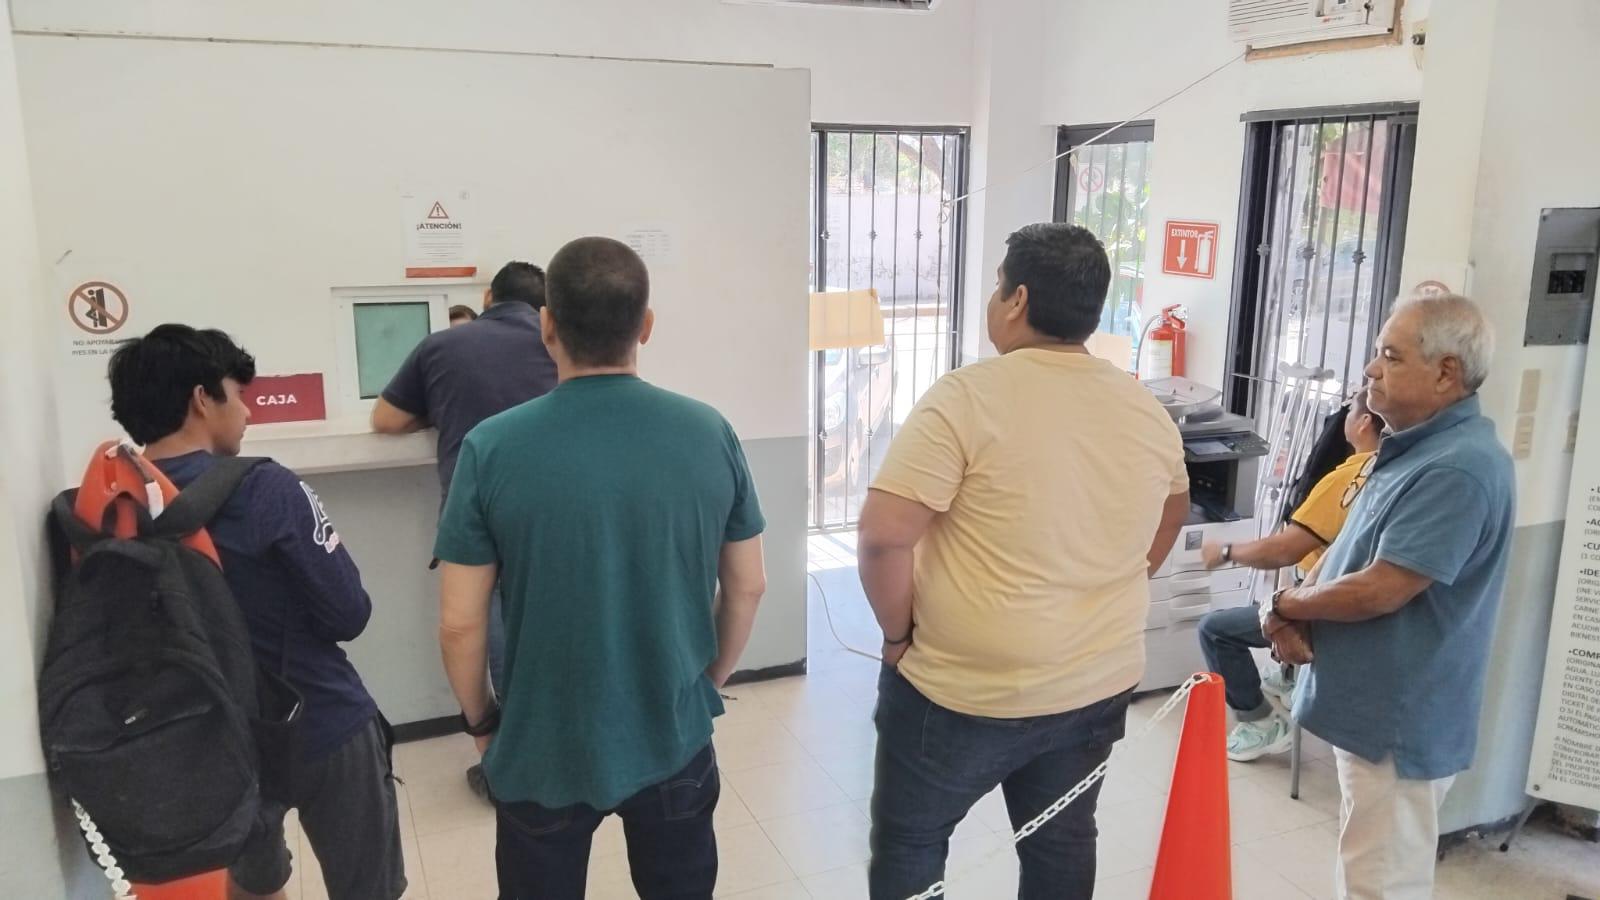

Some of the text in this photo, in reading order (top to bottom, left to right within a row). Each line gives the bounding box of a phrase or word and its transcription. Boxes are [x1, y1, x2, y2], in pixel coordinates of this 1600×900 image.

[416, 222, 462, 230] ¡ATENCIÓN!
[1171, 228, 1199, 239] EXTINTOR
[256, 394, 297, 406] CAJA
